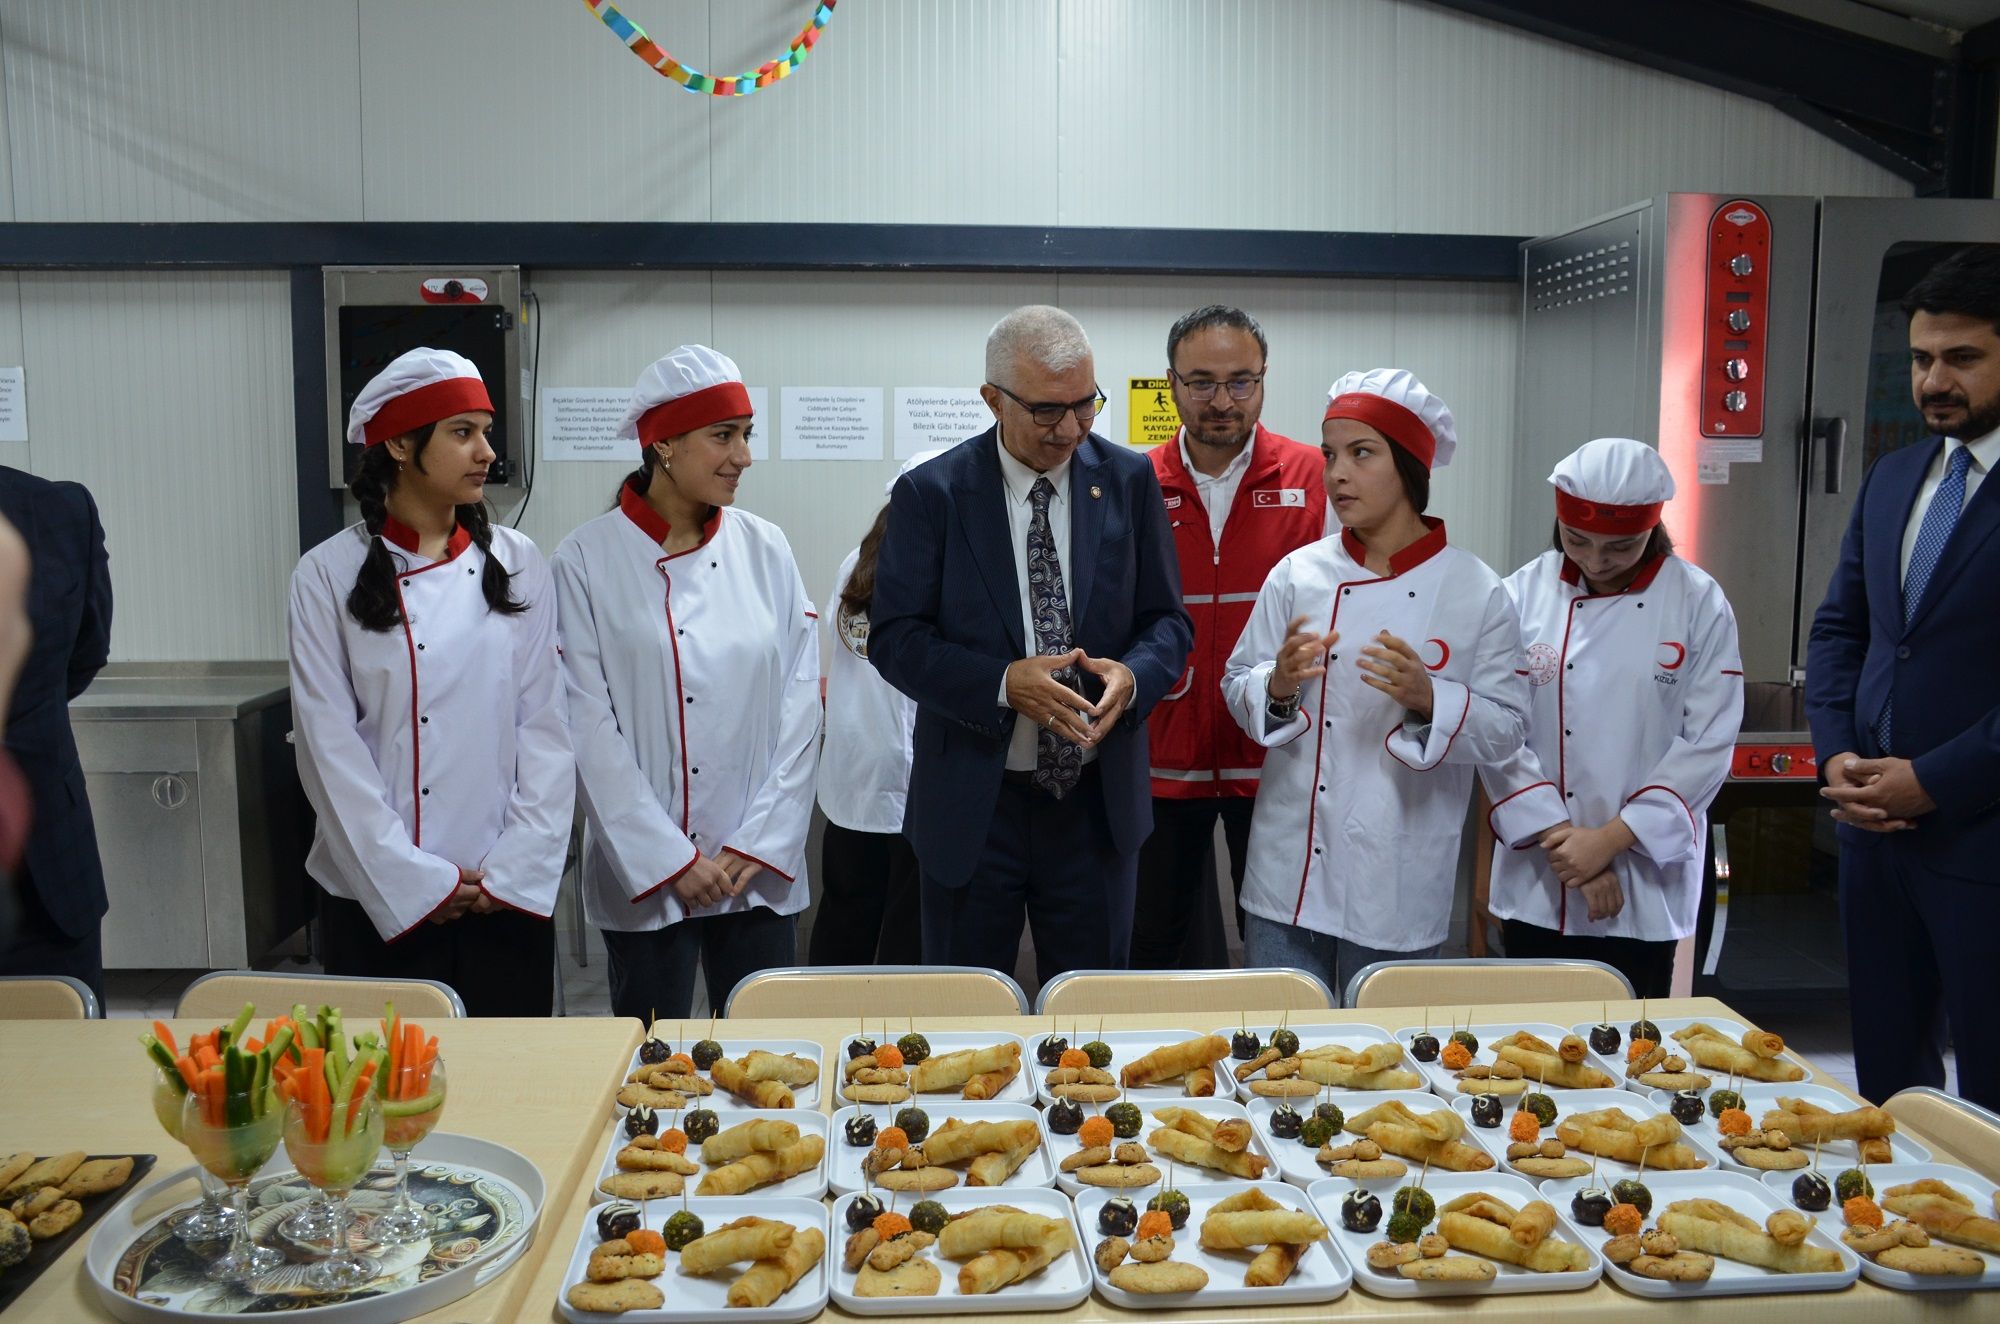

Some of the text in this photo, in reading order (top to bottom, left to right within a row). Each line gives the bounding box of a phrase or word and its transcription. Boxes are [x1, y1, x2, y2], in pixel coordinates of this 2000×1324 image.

[907, 398, 984, 407] Atölyelerde Çalışırken
[909, 410, 982, 419] Yüzük, Künye, Kolye,
[954, 423, 977, 431] Takılar
[928, 435, 962, 444] Takmayın
[1654, 674, 1679, 685] KIZILAY
